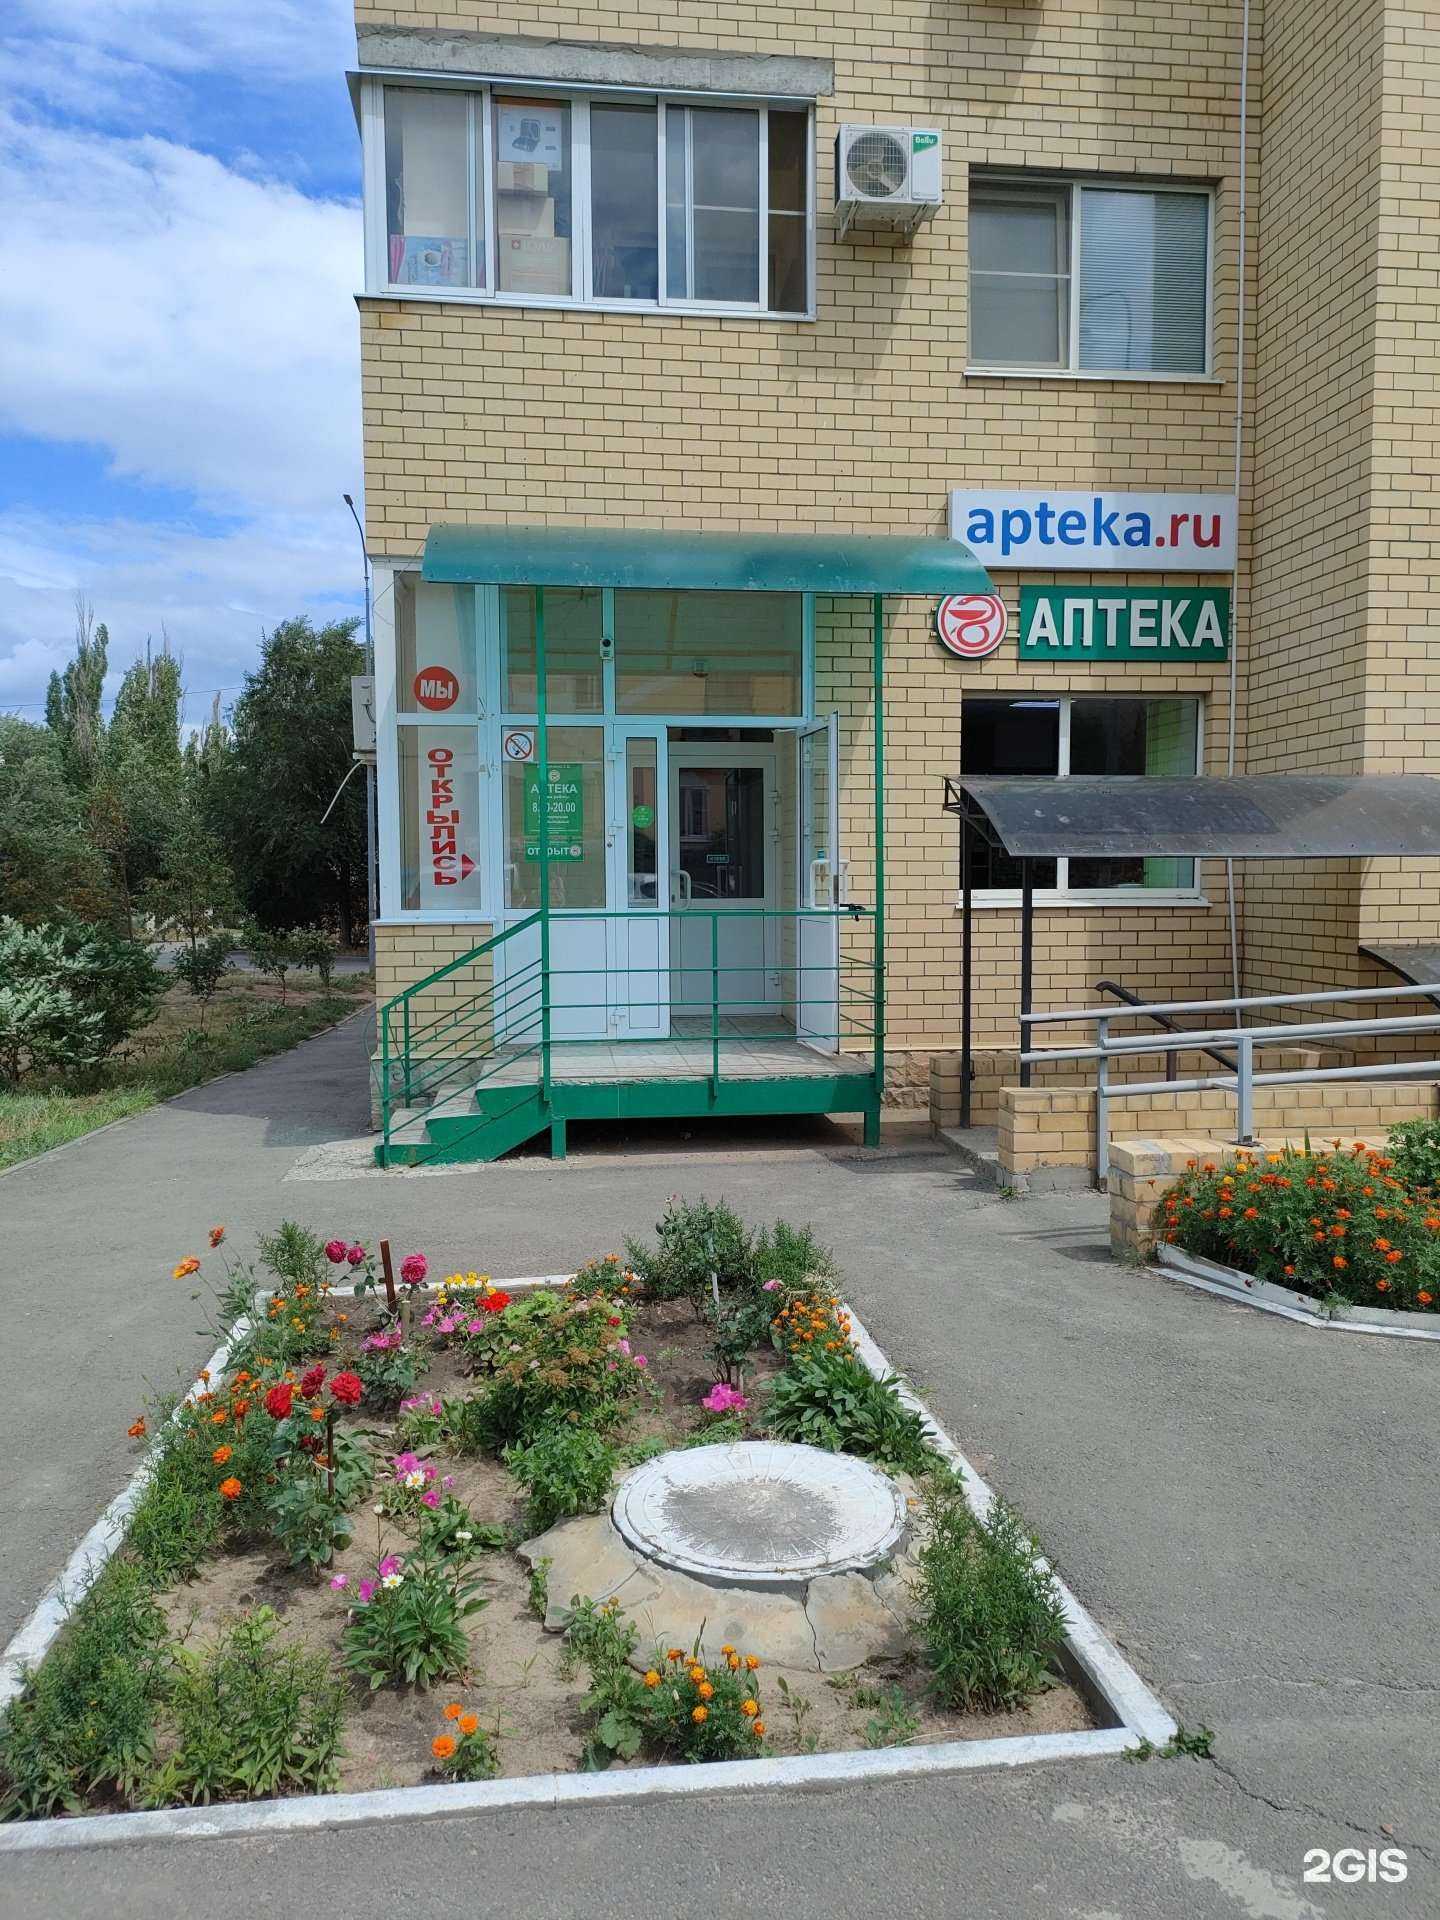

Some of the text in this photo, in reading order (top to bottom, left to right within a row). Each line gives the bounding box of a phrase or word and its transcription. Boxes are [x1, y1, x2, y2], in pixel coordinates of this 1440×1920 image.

[966, 497, 1222, 556] apteka.ru
[1026, 597, 1225, 648] АПТЕКА
[530, 783, 578, 794] АТЕКА
[426, 748, 460, 886] ОТКРЫЛИСЬ
